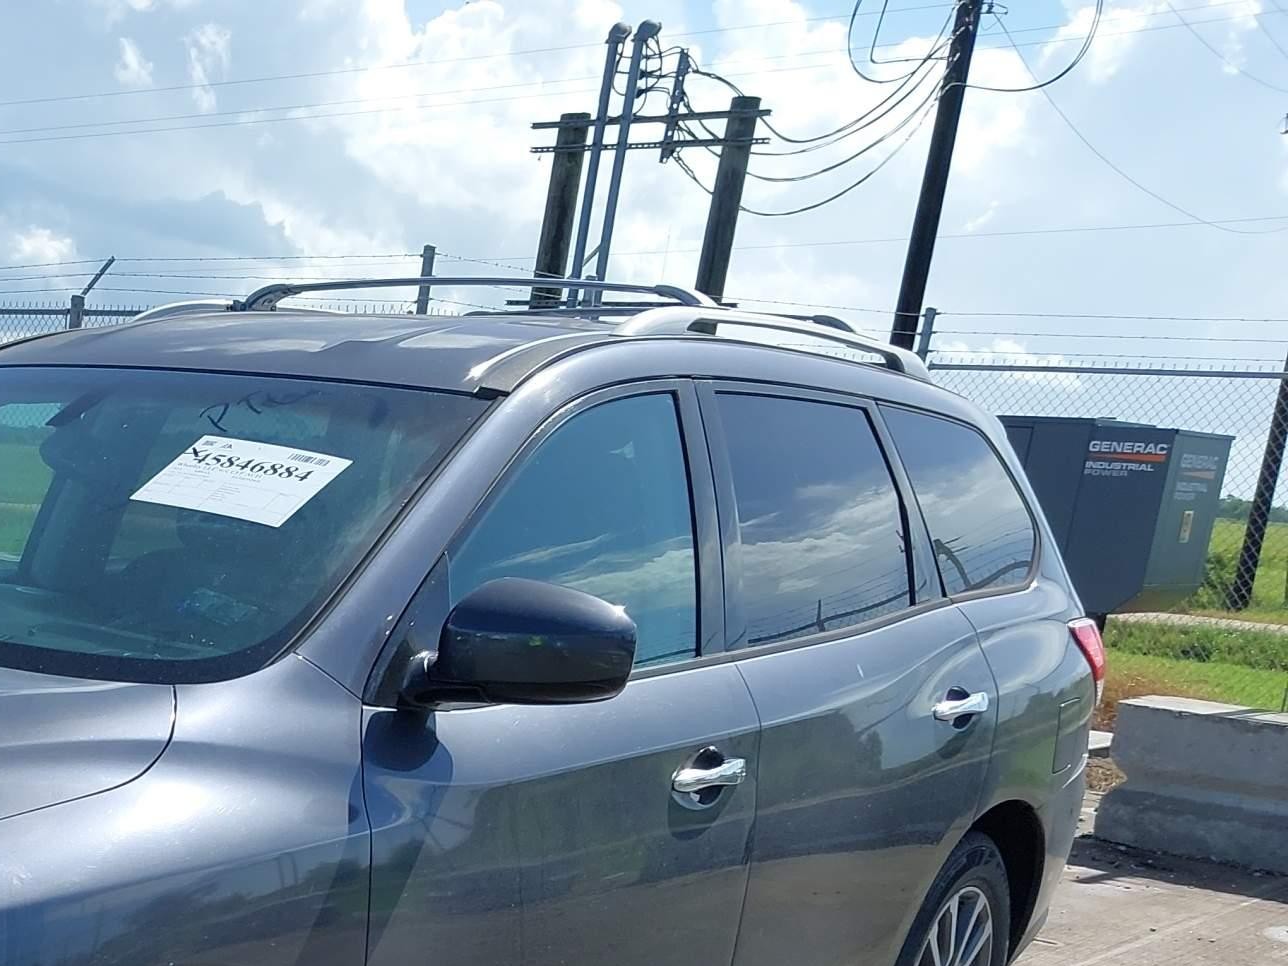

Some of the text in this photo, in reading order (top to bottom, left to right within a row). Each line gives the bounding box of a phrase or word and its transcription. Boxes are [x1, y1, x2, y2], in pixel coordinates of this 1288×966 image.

[1088, 440, 1168, 454] GENERAC
[1085, 461, 1154, 471] INDUSTRIAL
[1083, 468, 1128, 477] POWER
